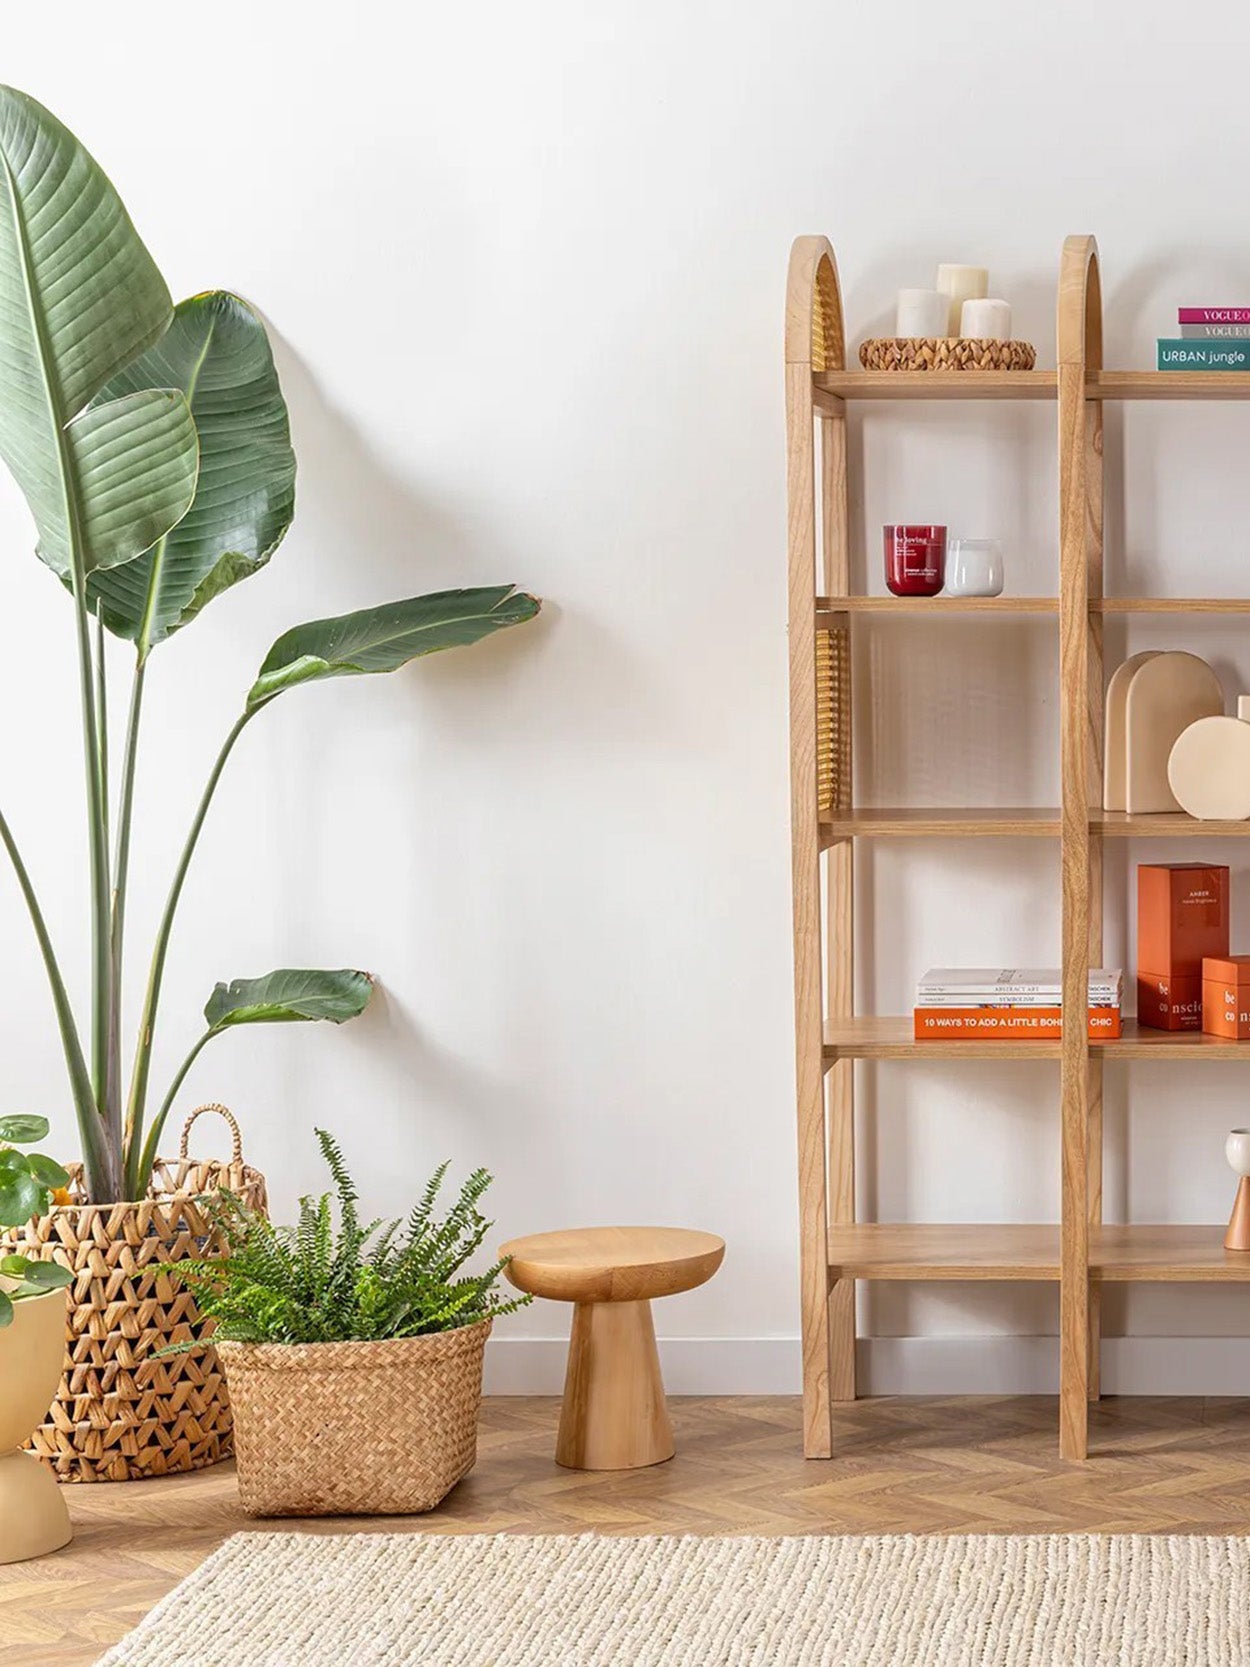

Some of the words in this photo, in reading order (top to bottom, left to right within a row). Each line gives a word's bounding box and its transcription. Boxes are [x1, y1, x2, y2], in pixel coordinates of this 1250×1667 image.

[1162, 351, 1206, 362] URBAN
[1208, 351, 1246, 364] jungle
[1224, 990, 1235, 1004] be
[924, 1018, 935, 1027] 10
[936, 1018, 962, 1027] WAYS
[964, 1018, 977, 1027] TO
[978, 1018, 998, 1027] ADD
[999, 1018, 1007, 1027] A
[1007, 1018, 1038, 1027] LITTLE
[1089, 1018, 1112, 1026] CHIC
